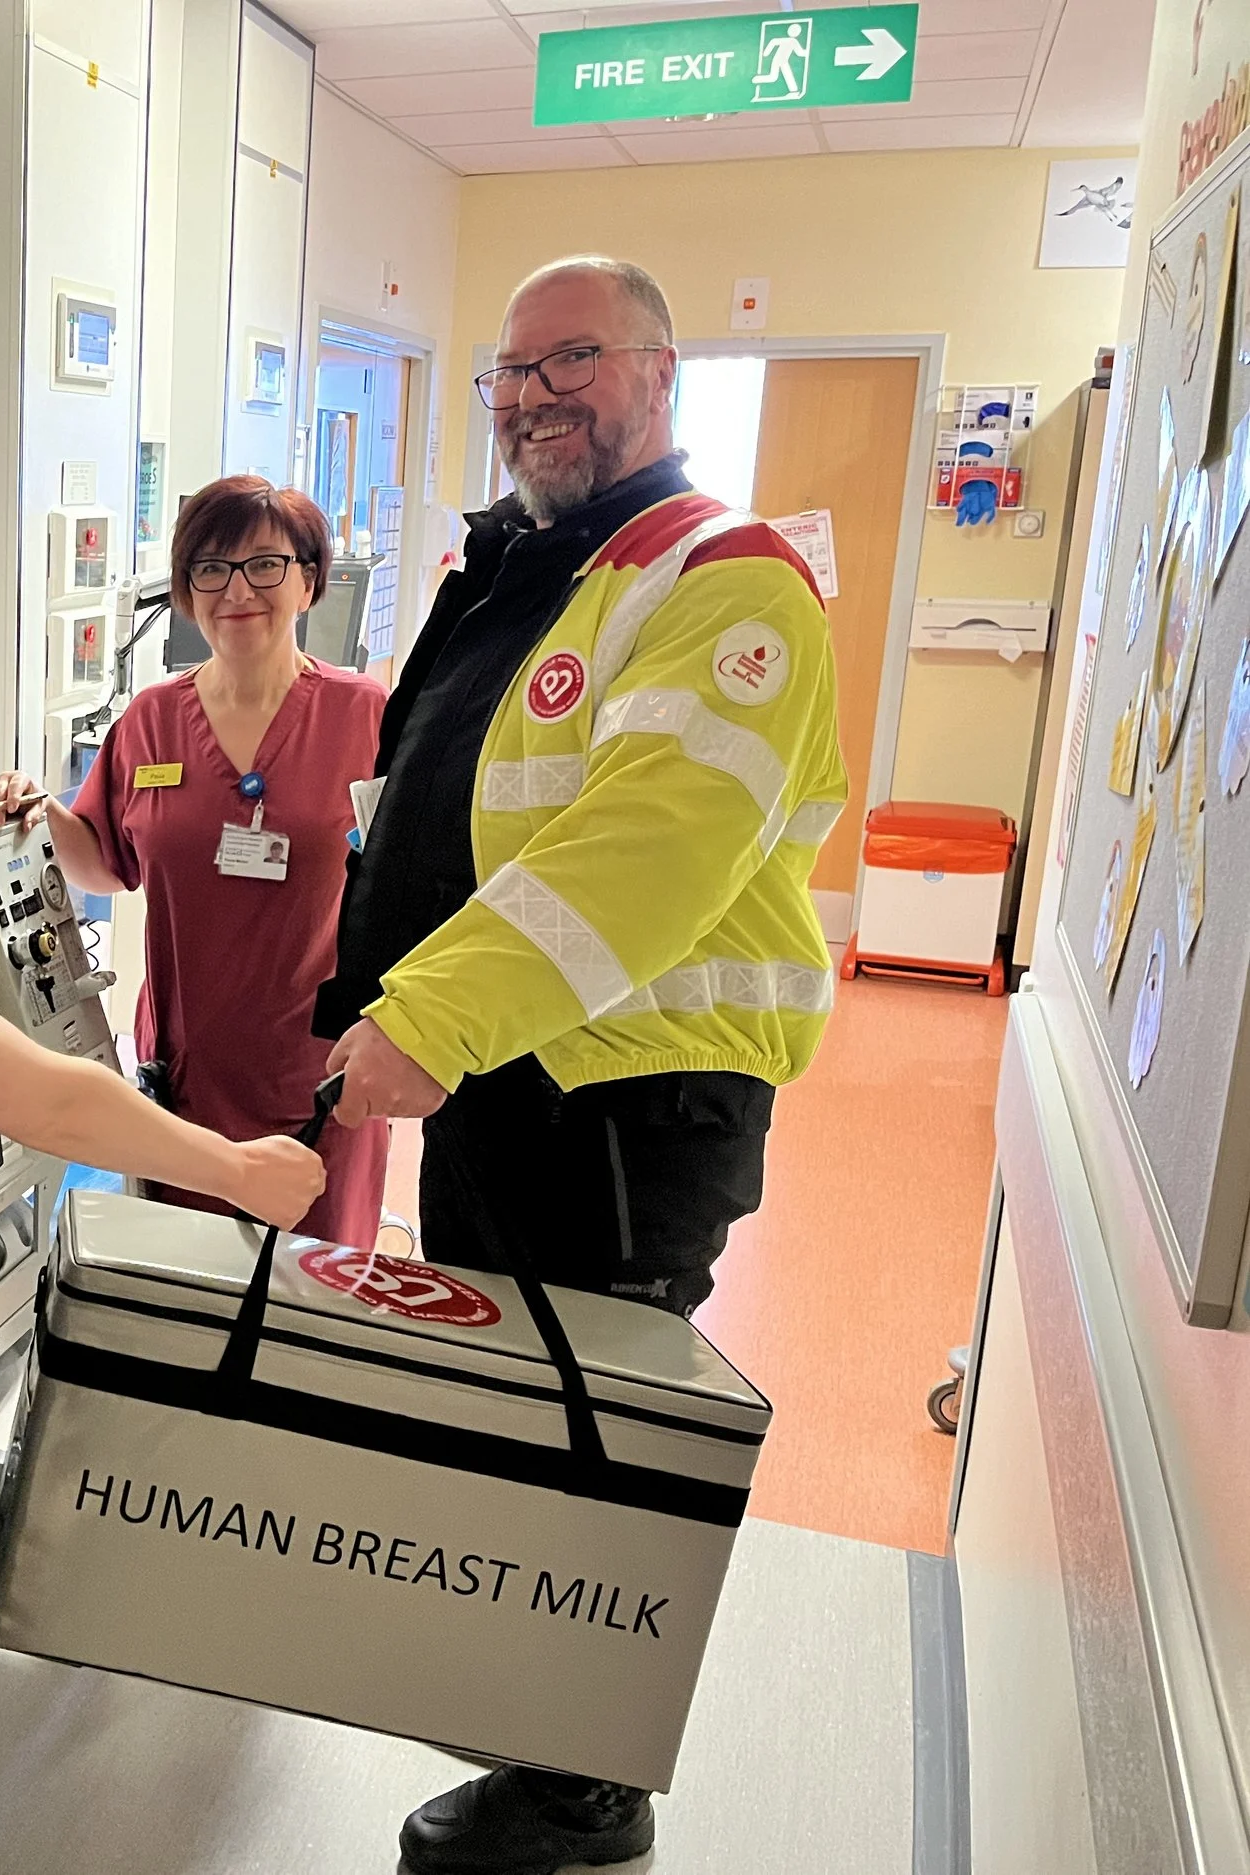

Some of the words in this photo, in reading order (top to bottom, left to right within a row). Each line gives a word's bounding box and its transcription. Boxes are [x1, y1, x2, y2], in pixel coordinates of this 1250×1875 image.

[574, 58, 646, 90] FIRE
[661, 50, 735, 83] EXIT
[74, 1467, 297, 1556] HUMAN
[310, 1521, 521, 1603] BREAST
[530, 1570, 671, 1639] MILK
